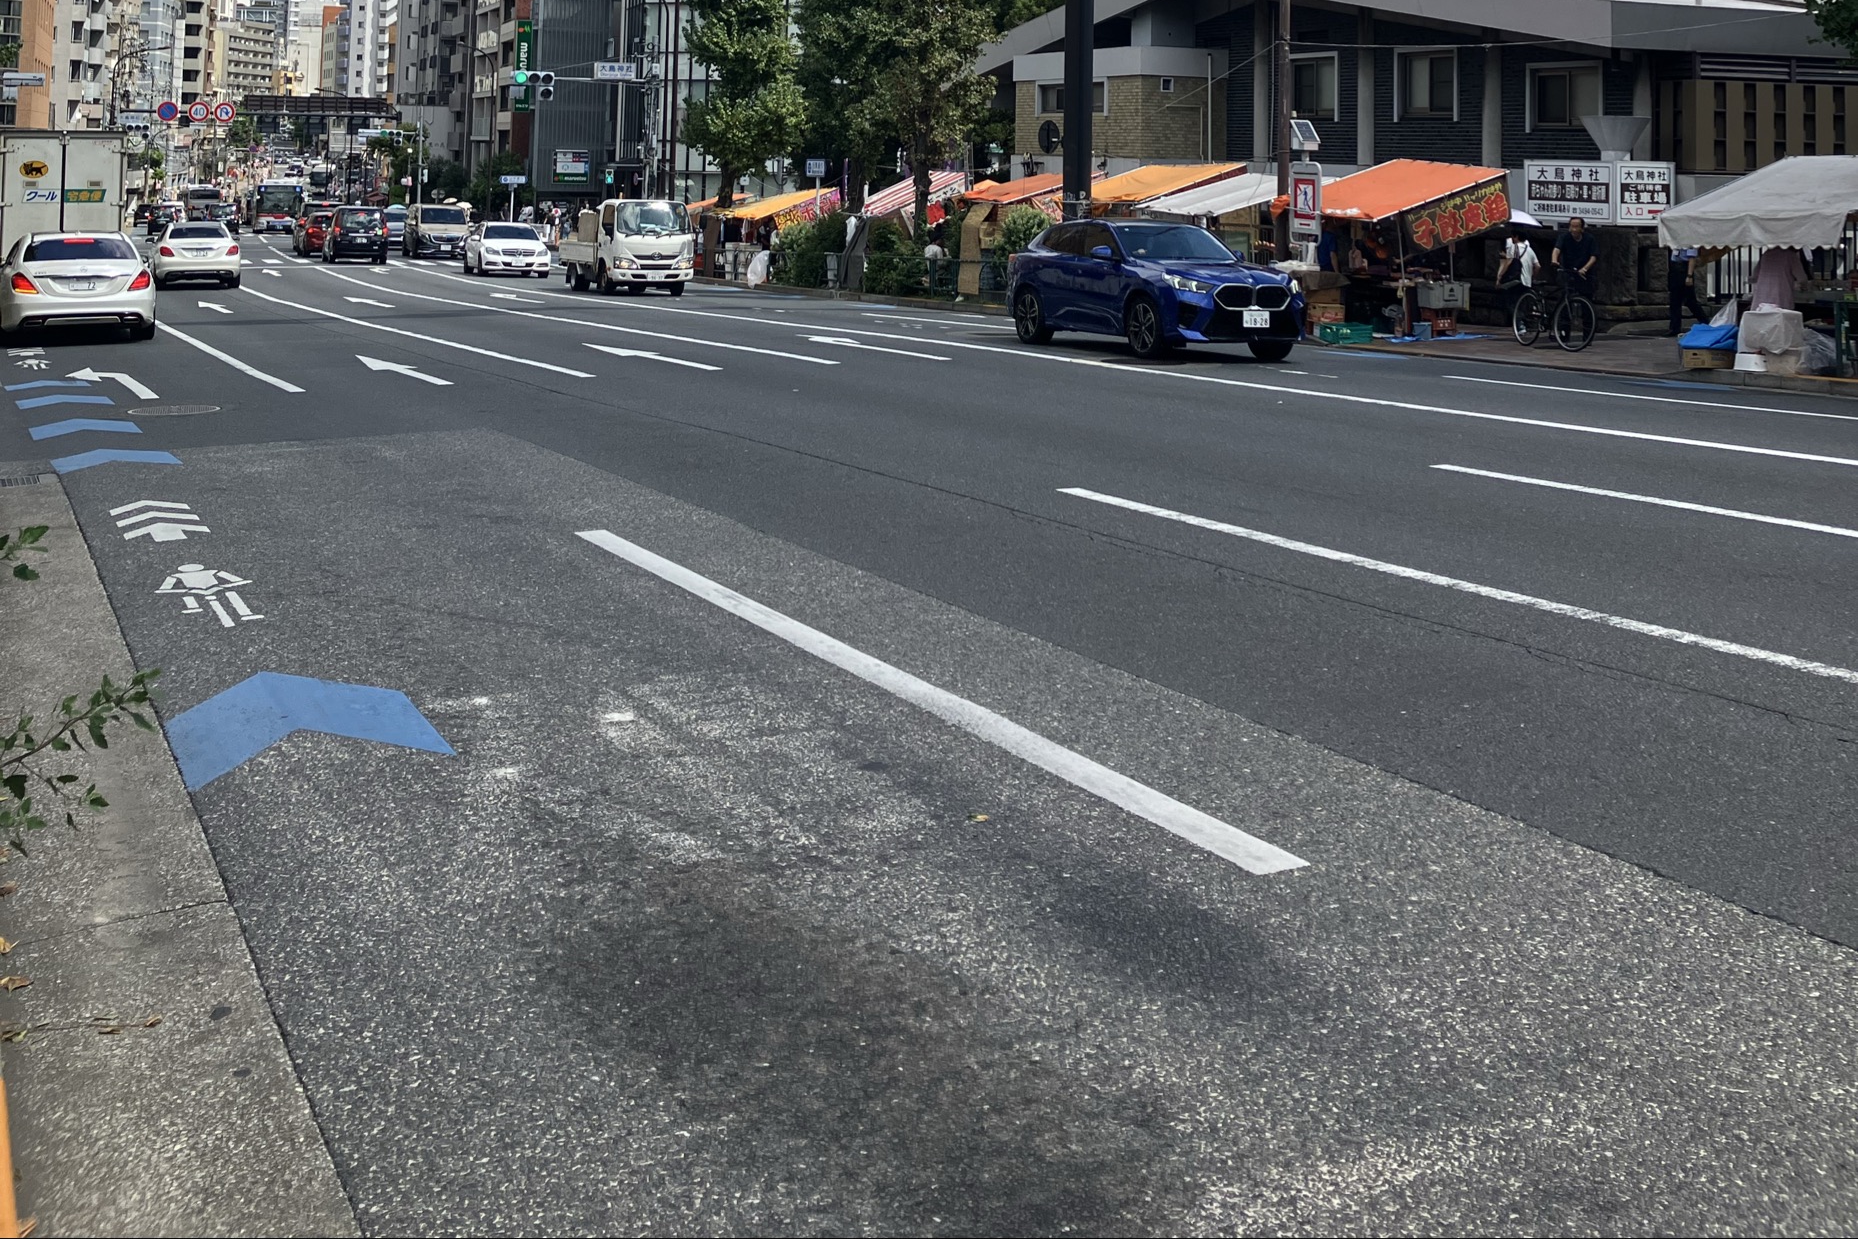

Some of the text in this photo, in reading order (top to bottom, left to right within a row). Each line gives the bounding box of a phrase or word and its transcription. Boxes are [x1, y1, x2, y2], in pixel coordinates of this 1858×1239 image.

[192, 107, 205, 117] 40
[1536, 166, 1600, 181] 大鳥神社
[1624, 170, 1667, 181] 大鳥神社
[26, 190, 102, 202] クール 宅急便
[1624, 191, 1667, 204] 駐車場
[1625, 206, 1644, 216] 入口
